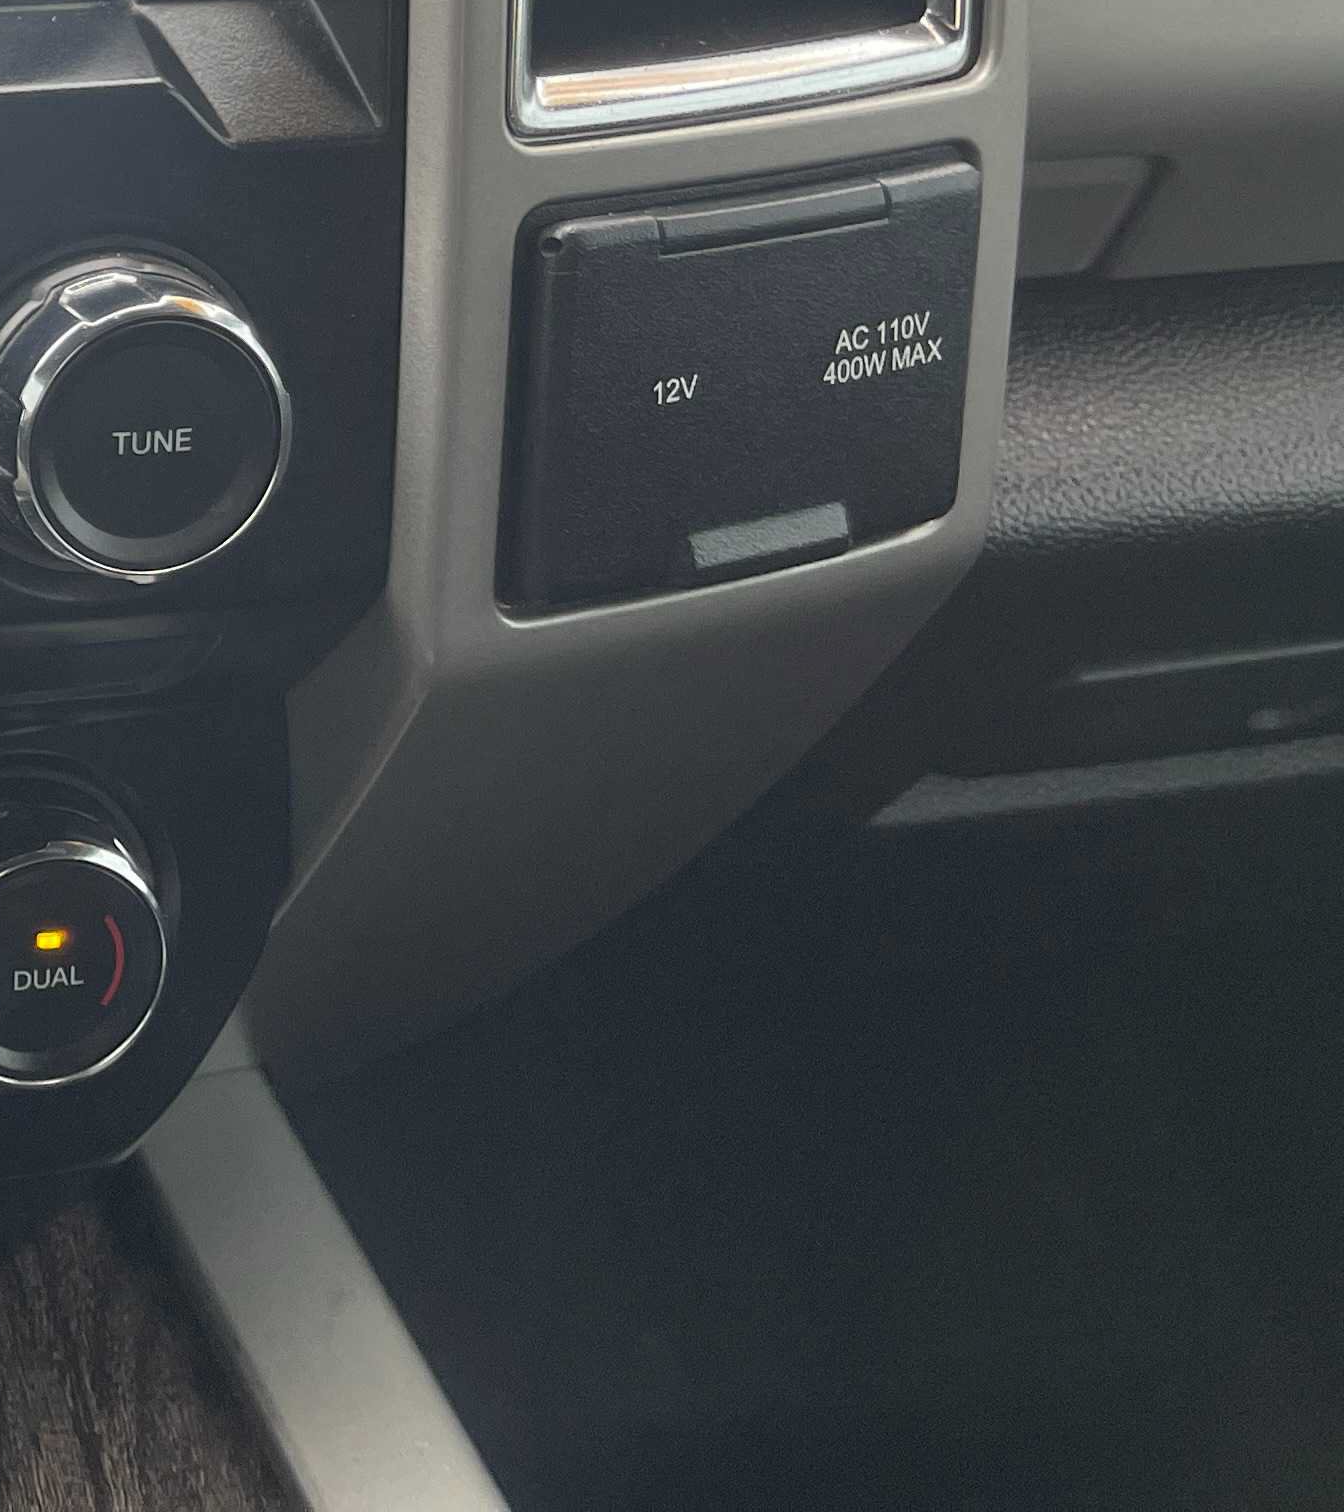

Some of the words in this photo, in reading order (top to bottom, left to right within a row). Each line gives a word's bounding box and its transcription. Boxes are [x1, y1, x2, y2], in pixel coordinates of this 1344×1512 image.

[835, 325, 869, 354] AC
[876, 311, 930, 346] 110V
[823, 350, 886, 384] 400W
[891, 338, 943, 371] MAX
[653, 375, 697, 405] 12V
[112, 428, 192, 456] TUNE
[13, 966, 84, 991] DUAL
